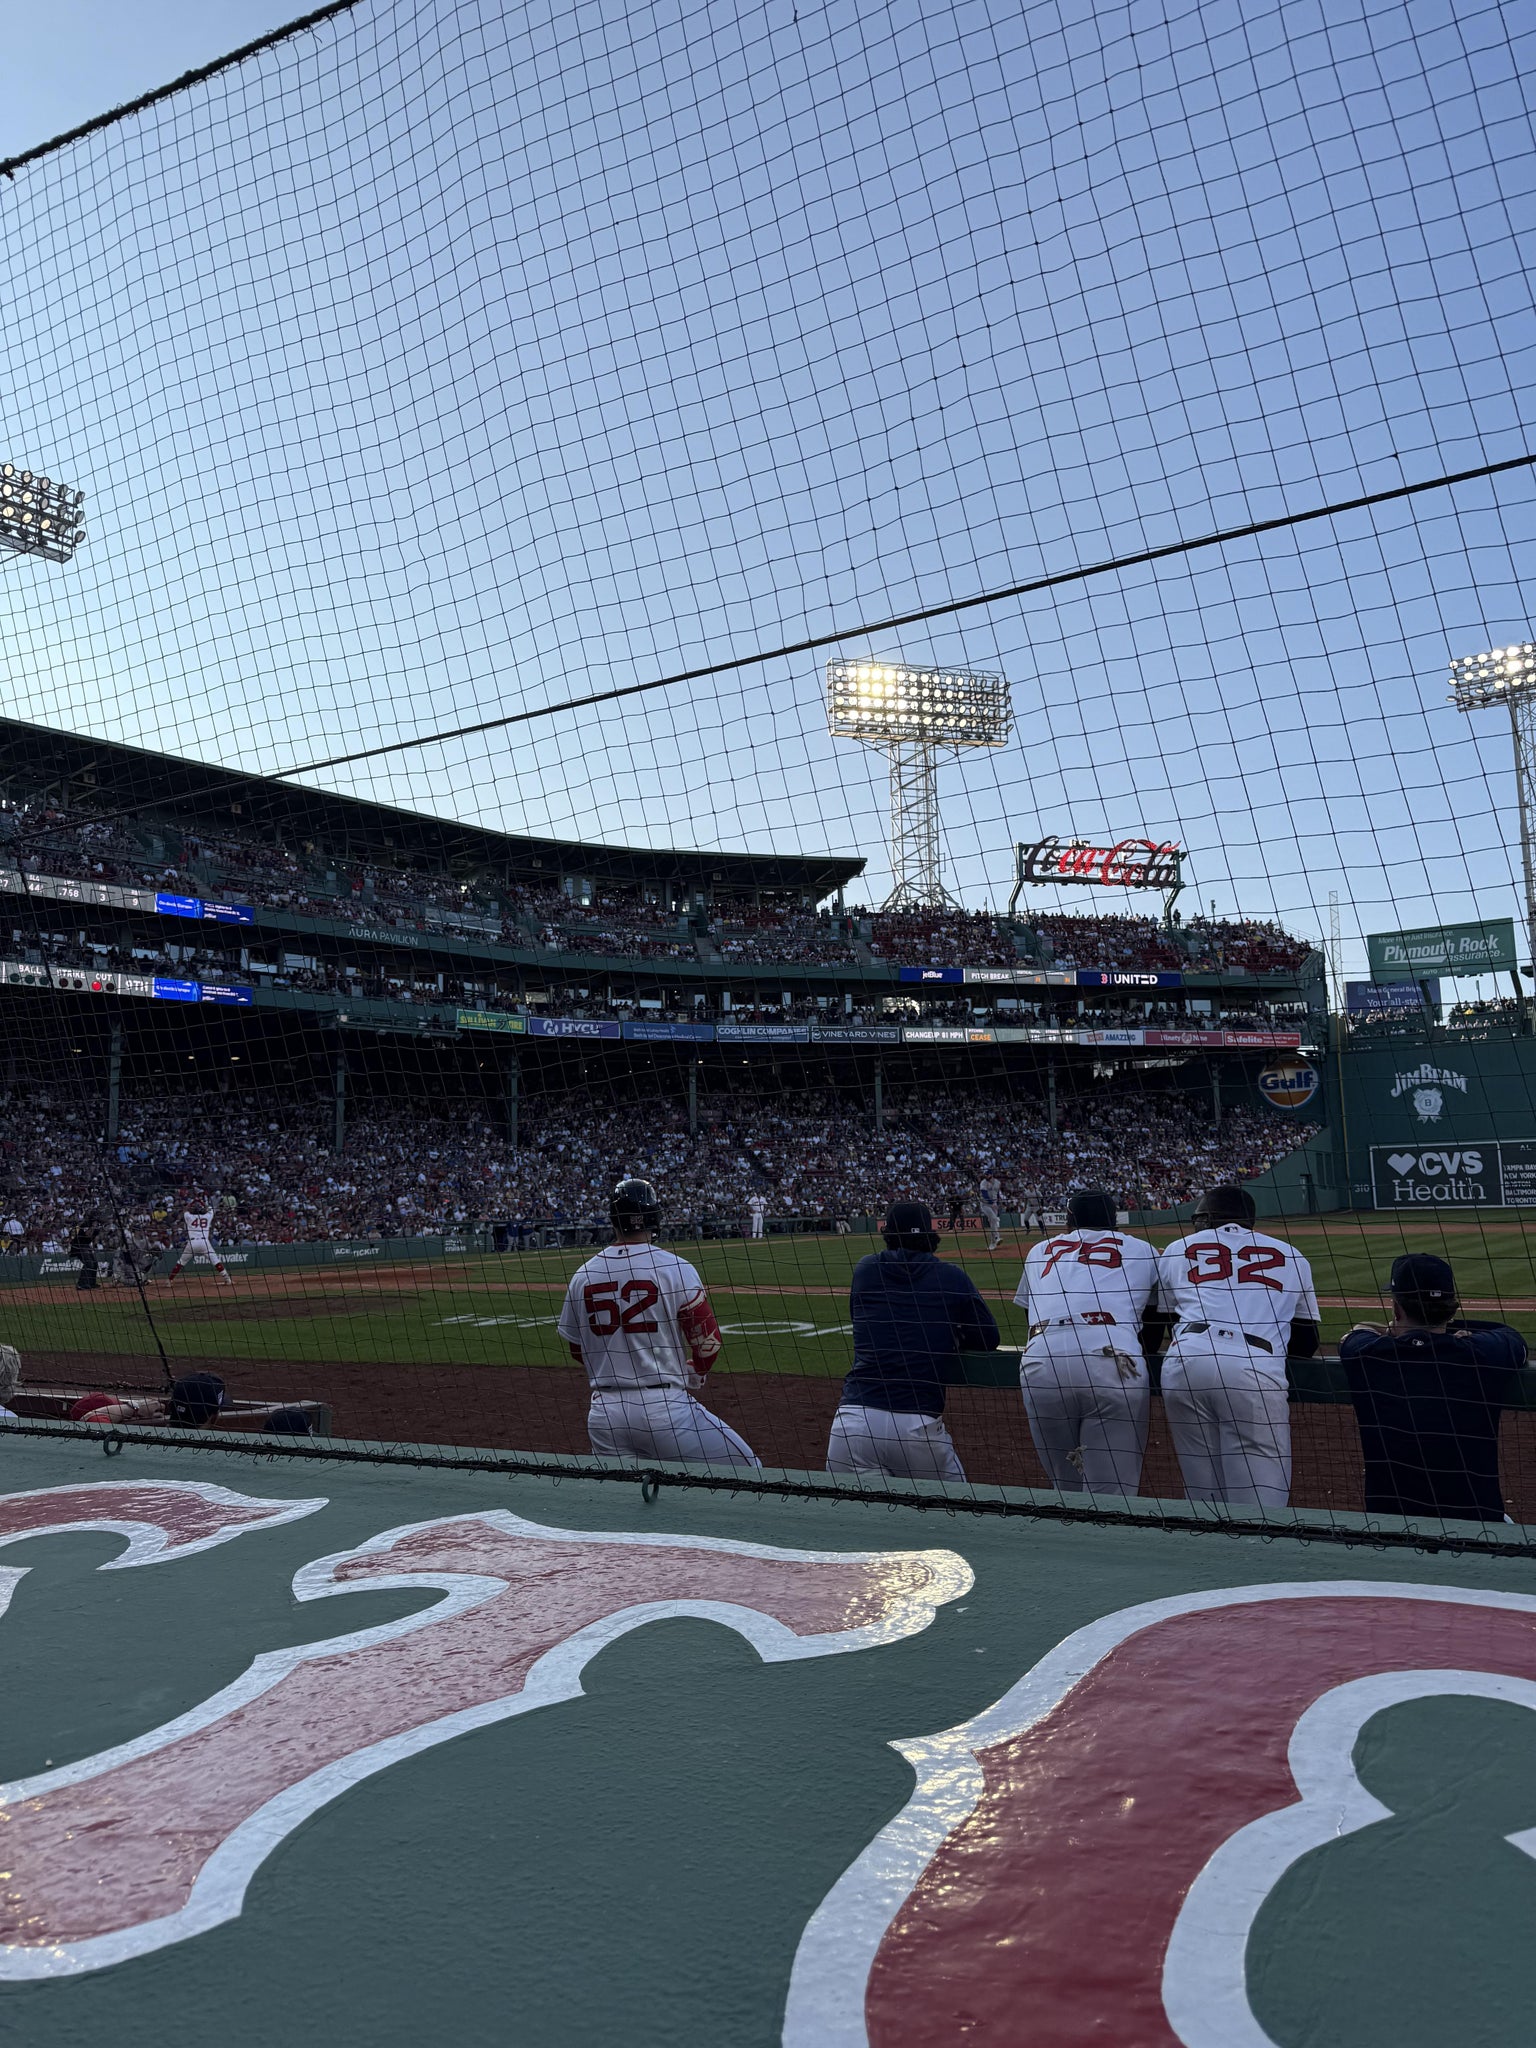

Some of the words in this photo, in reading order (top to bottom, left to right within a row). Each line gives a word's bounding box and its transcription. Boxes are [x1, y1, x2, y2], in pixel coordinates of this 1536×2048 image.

[1024, 836, 1181, 888] Coca-Cola
[100, 893, 106, 902] 3
[132, 898, 138, 906] 9
[348, 928, 378, 940] AURA
[1383, 939, 1455, 962] Plymouth
[1459, 934, 1500, 953] Rock
[19, 964, 42, 975] BALL
[56, 969, 86, 980] STRIKE
[922, 971, 943, 979] jetBlue
[95, 973, 113, 982] OUT
[971, 972, 989, 980] PITCH
[1113, 974, 1158, 984] UNITED
[1227, 1035, 1263, 1044] Safelite
[1260, 1071, 1313, 1090] Gulf
[1390, 1070, 1420, 1098] JIM
[1420, 1063, 1469, 1094] BEAM
[1418, 1151, 1483, 1176] CVS
[1392, 1178, 1487, 1202] Health
[191, 1218, 208, 1229] 48
[1040, 1237, 1123, 1279] 75
[1184, 1242, 1286, 1293] 32
[583, 1279, 659, 1336] 52
